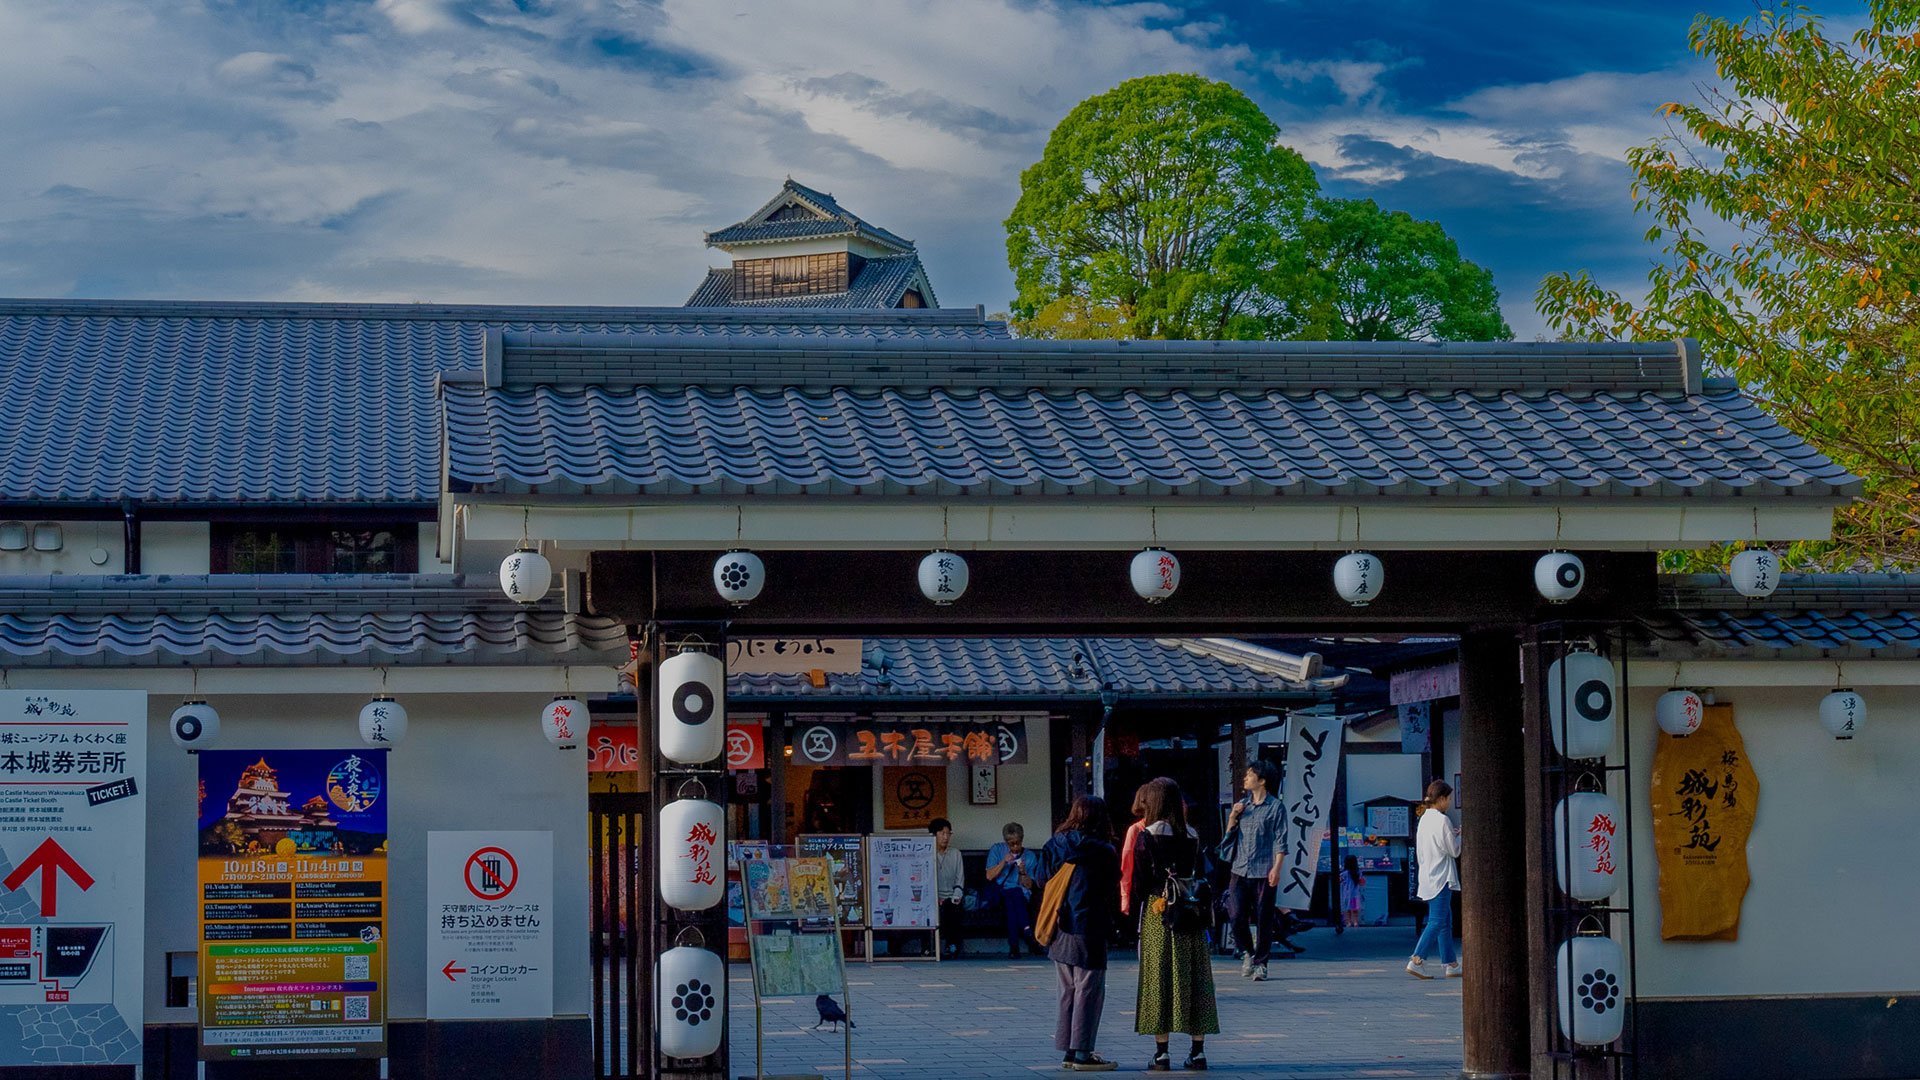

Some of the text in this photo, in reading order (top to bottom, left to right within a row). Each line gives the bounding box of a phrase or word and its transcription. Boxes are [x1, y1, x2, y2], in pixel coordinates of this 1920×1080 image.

[937, 558, 955, 594] 桜の小路
[1755, 555, 1770, 590] 桜の小路
[372, 706, 389, 743] 桜の小路
[552, 705, 574, 739] 城彩苑
[1680, 695, 1698, 729] 城彩苑
[73, 732, 127, 744] わくわく座
[849, 729, 994, 761] 五木屋本舗
[1, 751, 126, 774] 本城券売所
[1721, 750, 1739, 809] 桜の馬場
[90, 784, 125, 802] TICKET
[1669, 769, 1721, 852] 城彩苑
[678, 822, 716, 886] 城彩苑
[1580, 813, 1617, 875] 城彩苑
[442, 904, 539, 912] 天守閣内にスーツケースは
[442, 915, 540, 928] 持ち込めません
[471, 965, 538, 974] コインロッカー
